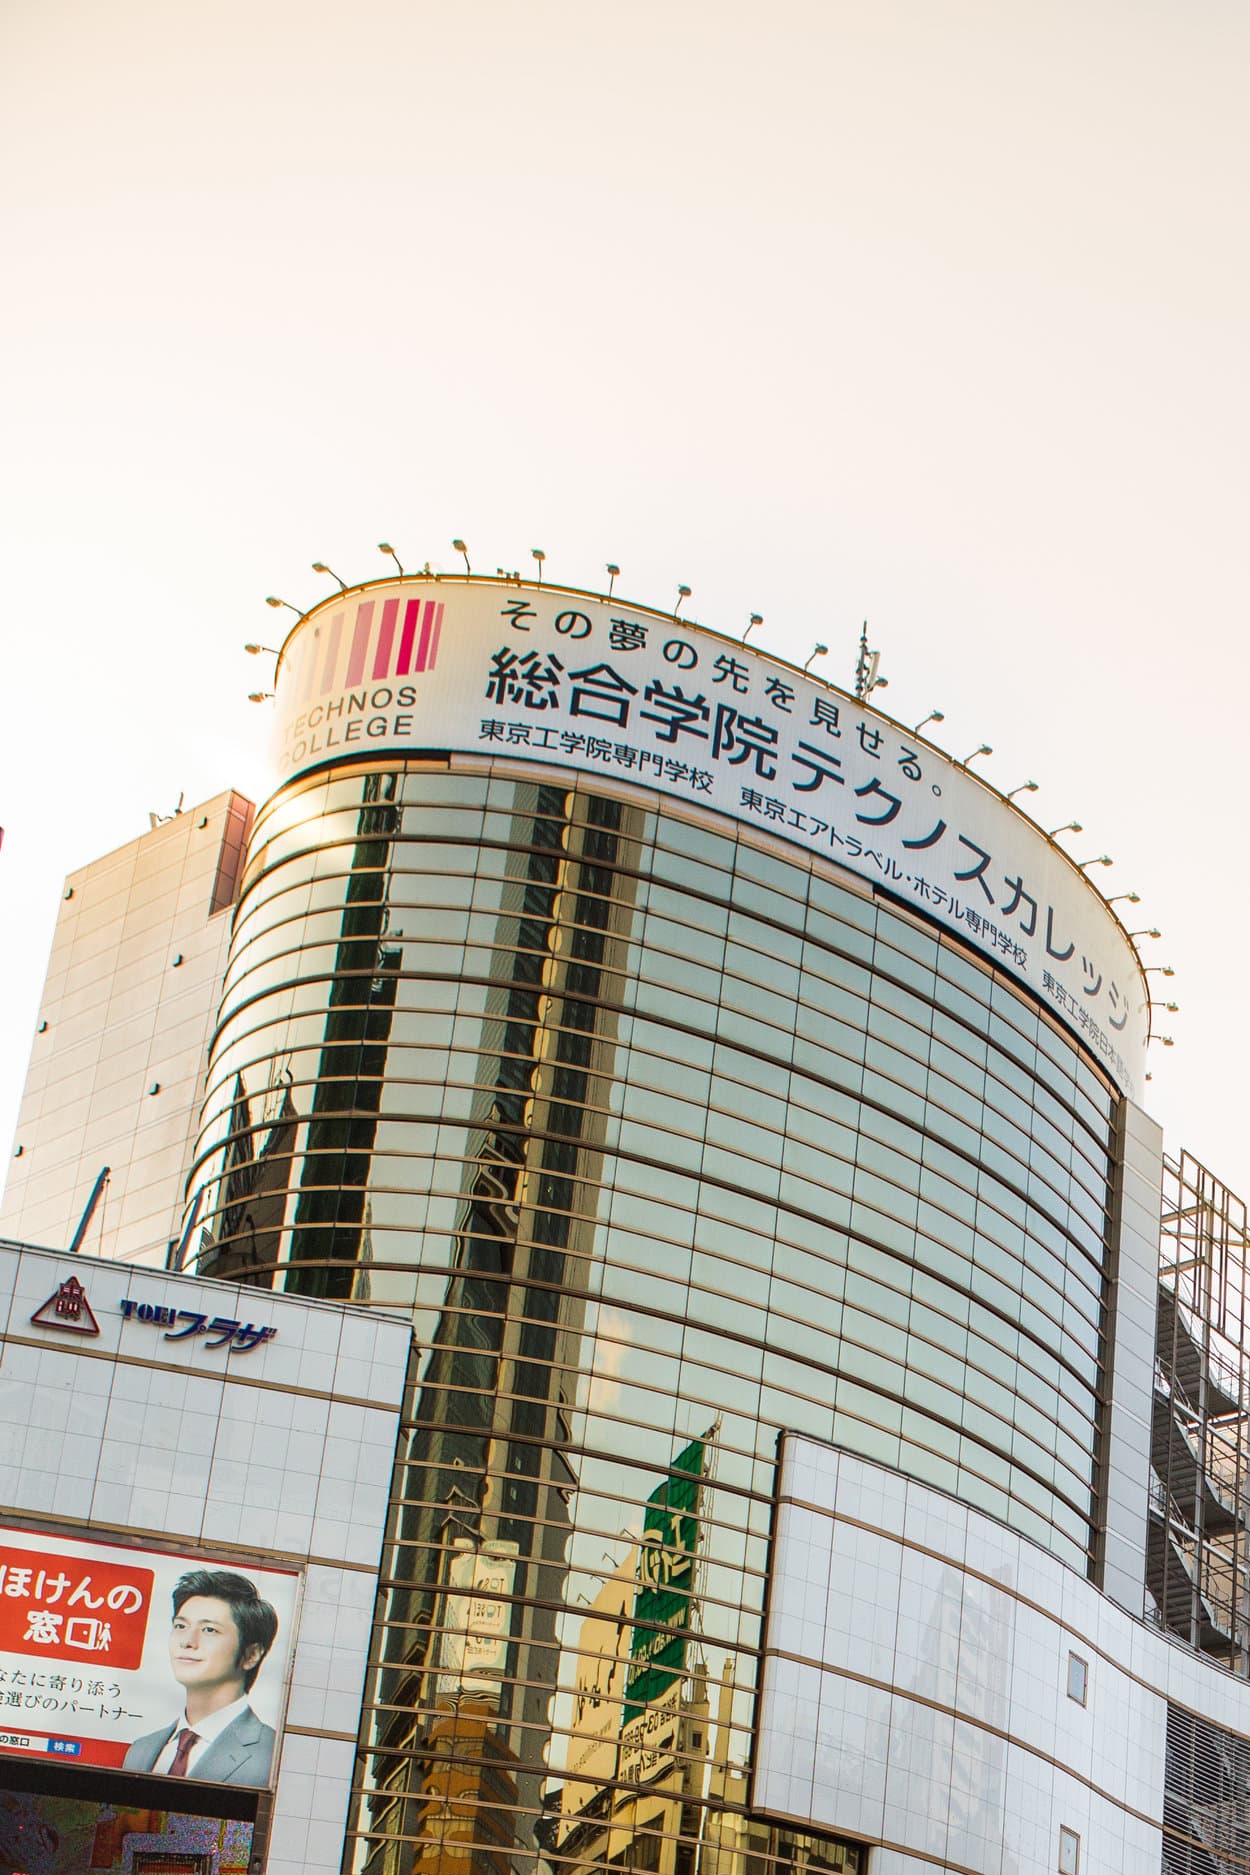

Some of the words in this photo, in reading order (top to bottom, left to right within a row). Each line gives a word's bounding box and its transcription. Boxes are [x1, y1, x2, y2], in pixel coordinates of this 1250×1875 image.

[280, 714, 413, 768] COLLEGE
[283, 686, 418, 742] TECHNOS
[478, 719, 715, 795] 東京工学院専門学校
[485, 645, 1130, 1032] 総合学院テクノスカレッジ
